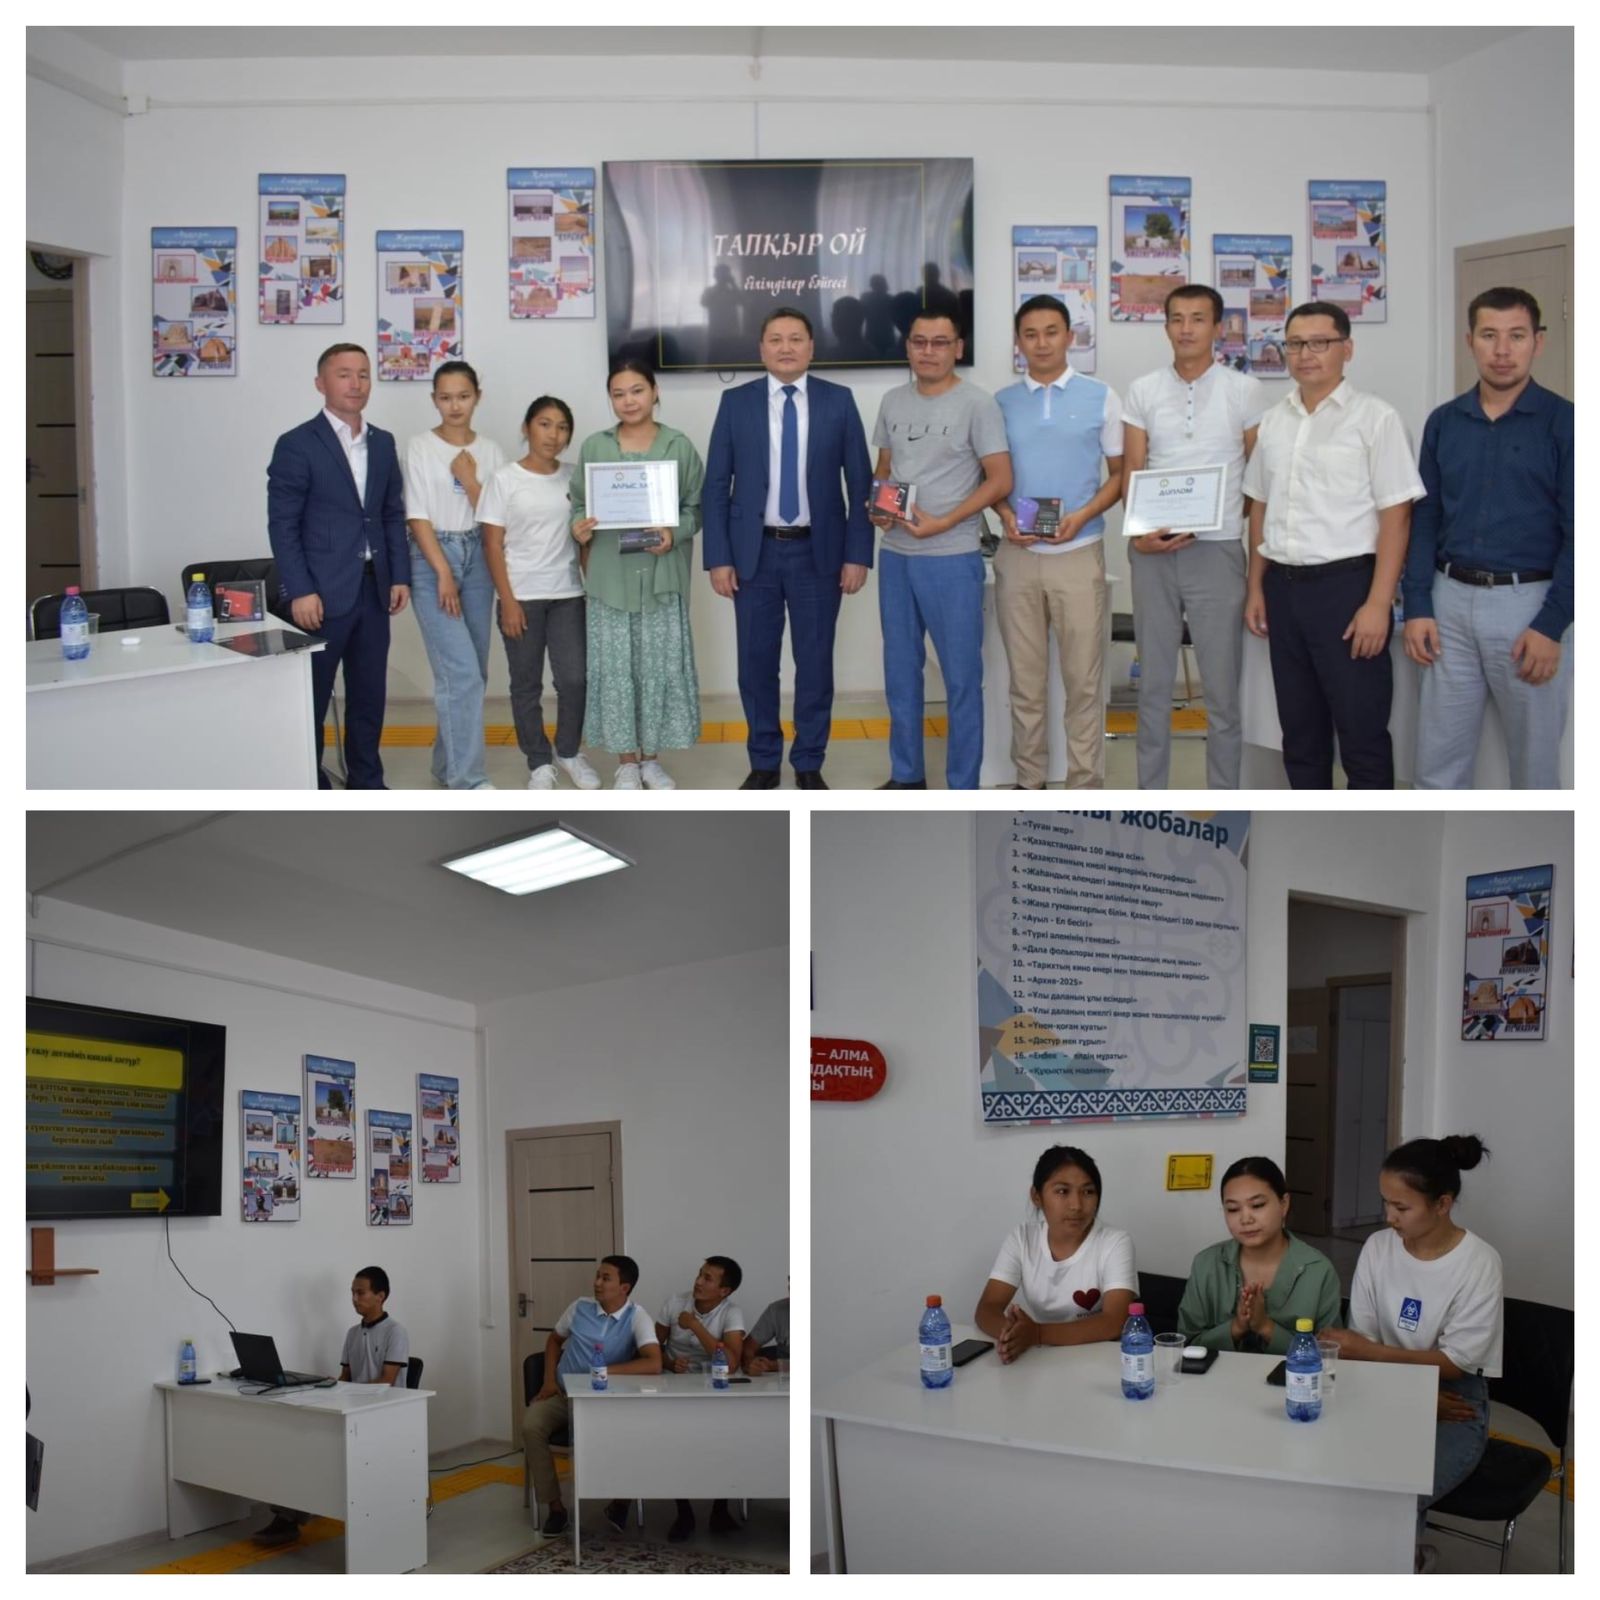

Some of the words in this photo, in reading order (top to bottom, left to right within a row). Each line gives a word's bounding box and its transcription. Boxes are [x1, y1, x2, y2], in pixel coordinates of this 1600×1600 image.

[714, 233, 824, 259] ТАПҚЫР
[829, 226, 867, 255] ОЙ
[744, 276, 805, 296] білімділер
[808, 275, 847, 290] бәйгесі
[1013, 818, 1020, 826] 1.
[1022, 820, 1050, 831] «Туған
[1053, 826, 1074, 835] жер»
[1120, 811, 1229, 848] жобалар
[1012, 833, 1020, 842] 2.
[1022, 836, 1087, 853] «Қазақстандағы
[1090, 846, 1103, 855] 100
[1012, 849, 1020, 858] 3.
[1022, 852, 1084, 868] «Қазақстанның
[1012, 865, 1020, 874] 4.
[1012, 881, 1020, 890] 5.
[1022, 883, 1051, 894] «Қазақ
[1012, 896, 1020, 905] 6.
[1052, 902, 1107, 916] гуманитарлық
[1182, 918, 1194, 926] 100
[1012, 912, 1020, 921] 7.
[1022, 914, 1048, 925] «Ауыл
[1056, 918, 1066, 926] Ел
[1012, 928, 1020, 936] 8.
[1022, 930, 1048, 940] «Түркі
[1012, 944, 1020, 952] 9.
[1022, 945, 1048, 954] «Дала
[1013, 975, 1025, 983] 11.
[1027, 976, 1083, 986] «Архив-2025»
[1013, 990, 1025, 998] 12.
[1014, 1006, 1025, 1014] 13.
[1014, 1021, 1026, 1029] 14.
[1014, 1036, 1026, 1044] 15.
[829, 1049, 869, 1061] АЛМА
